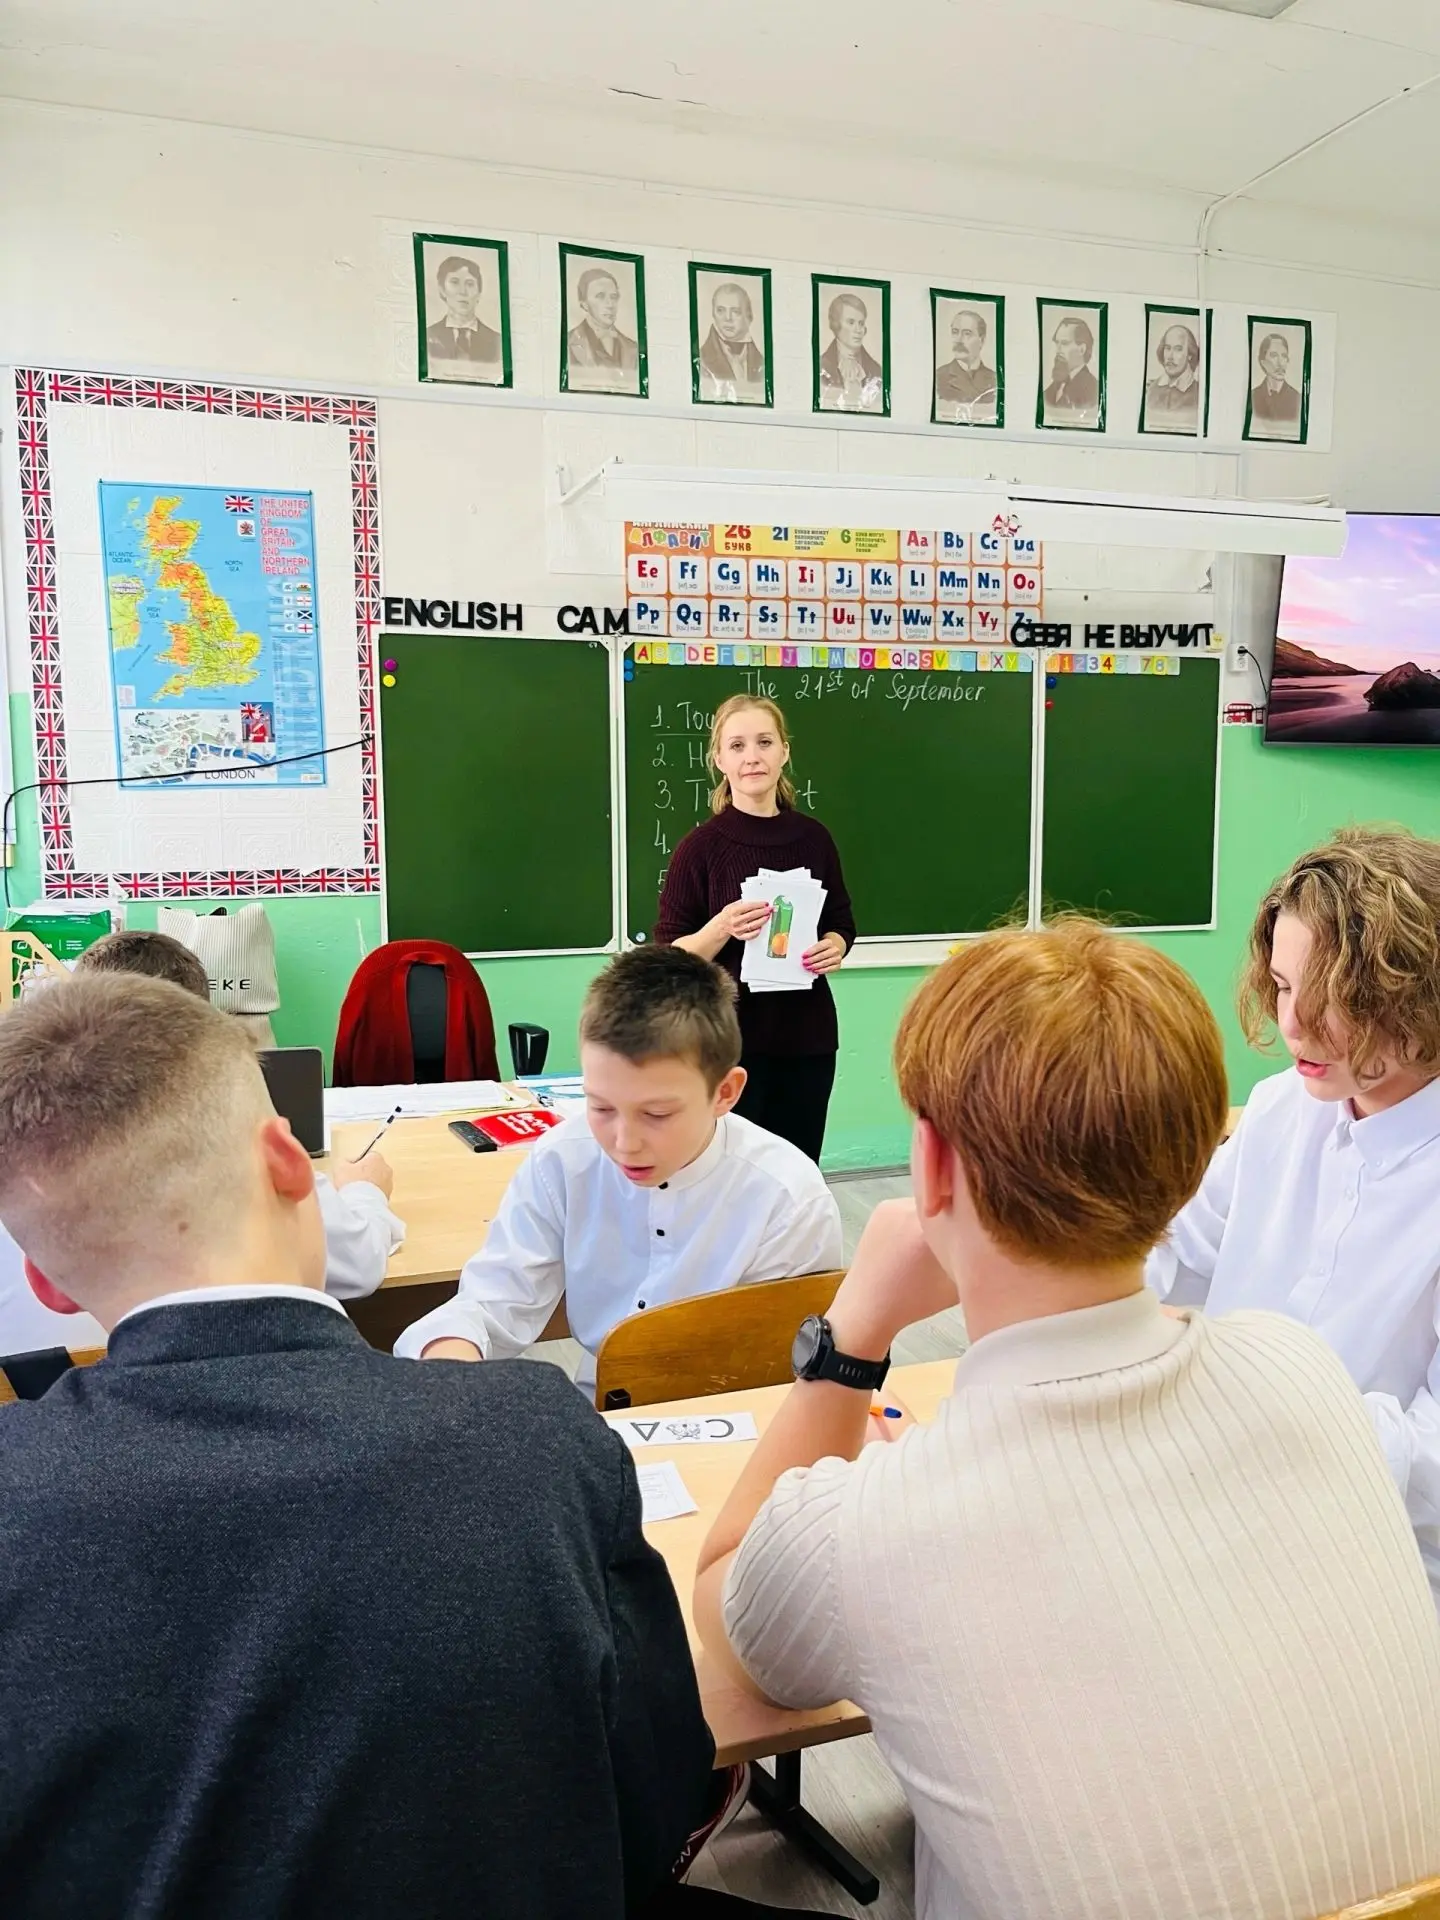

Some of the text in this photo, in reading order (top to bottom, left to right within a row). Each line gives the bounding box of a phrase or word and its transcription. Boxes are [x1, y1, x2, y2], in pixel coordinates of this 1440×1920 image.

[260, 498, 309, 510] THE UNITED
[260, 509, 302, 518] KINGDOM
[260, 518, 272, 526] OF
[261, 528, 289, 536] GREAT
[630, 528, 711, 549] АЛФАВИТ
[772, 526, 789, 541] 21
[841, 529, 851, 544] 6
[907, 530, 928, 547] Aa
[944, 532, 964, 548] Bb
[980, 533, 998, 550] Cc
[262, 538, 296, 547] BRITAIN
[724, 542, 752, 552] БУКВ
[262, 557, 310, 566] NORTHERN
[264, 566, 300, 575] IRELAND
[637, 560, 658, 578] Ee
[680, 561, 697, 579] Ff
[718, 563, 740, 584] Gg
[757, 565, 779, 583] Hh
[798, 566, 814, 583] Ii
[836, 568, 852, 588] Jj
[871, 568, 892, 586] Kk
[940, 571, 968, 589] Mm
[978, 573, 1000, 590] Nn
[1013, 574, 1035, 590] Oo
[384, 597, 522, 631] ENGLISH
[636, 603, 660, 624] Pp
[676, 604, 701, 625] Qq
[718, 605, 739, 622] Rr
[759, 606, 778, 623] Ss
[798, 607, 816, 624] Tt
[832, 608, 855, 625] Uu
[870, 609, 892, 626] Vv
[903, 609, 932, 626] Ww
[942, 611, 964, 628] Xx
[978, 612, 998, 631] Yy
[1085, 624, 1115, 648] НЕ
[1120, 623, 1213, 648] ВЫУЧИТ
[638, 645, 649, 661] A
[688, 646, 700, 661] D
[704, 647, 715, 662] E
[721, 648, 732, 663] F
[752, 648, 762, 663] H
[784, 649, 794, 663] J
[832, 650, 841, 664] M
[862, 651, 872, 666] O
[892, 653, 902, 666] Q
[908, 652, 917, 666] R
[922, 653, 932, 667] S
[936, 652, 946, 668] V
[993, 655, 1003, 668] X
[1007, 655, 1016, 668] Y
[1063, 656, 1070, 669] 1
[1076, 656, 1085, 669] 2
[1089, 657, 1099, 670] 3
[1103, 657, 1112, 670] 4
[1142, 658, 1150, 671] 7
[1156, 659, 1164, 672] 8
[740, 670, 985, 711] The 21st of September
[650, 705, 671, 728] 1.
[652, 743, 674, 767] 2.
[204, 769, 255, 780] LONDON
[655, 780, 674, 811] 3.
[654, 818, 671, 854] 4.
